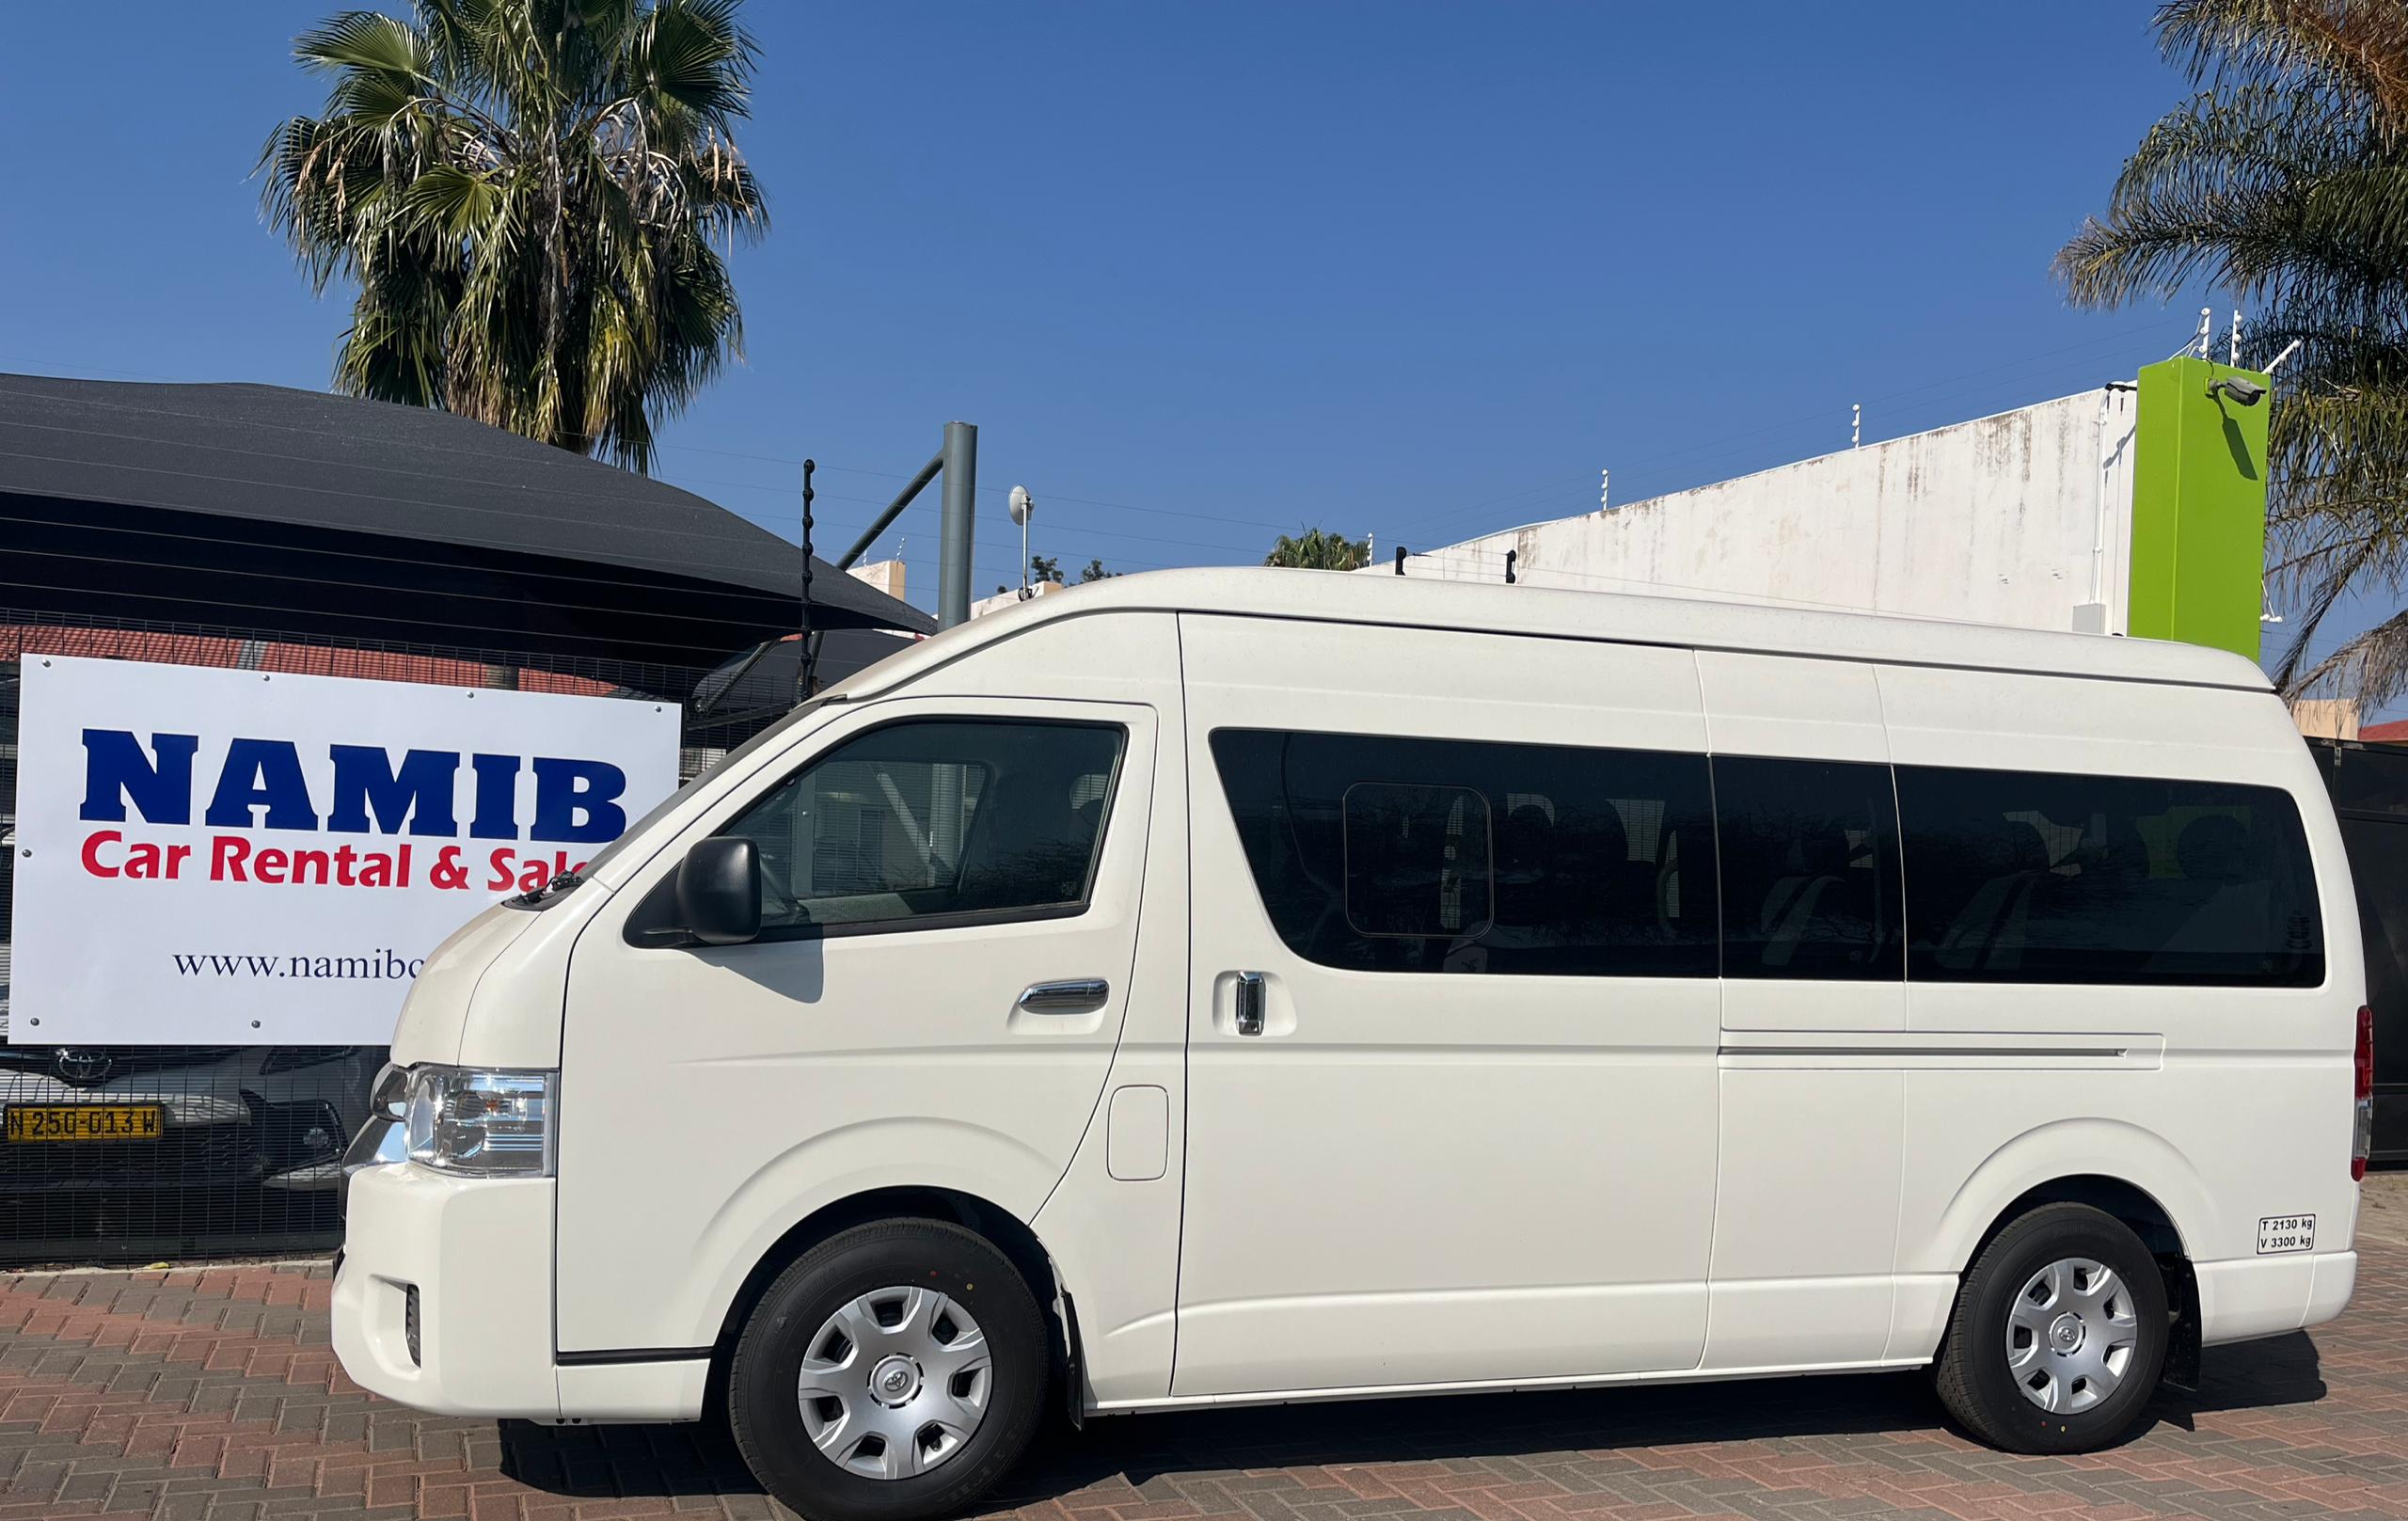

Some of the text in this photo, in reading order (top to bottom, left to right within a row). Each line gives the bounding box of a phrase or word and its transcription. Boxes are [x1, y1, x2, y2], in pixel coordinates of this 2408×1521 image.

[79, 728, 627, 844] NAMIB
[81, 830, 588, 893] Car Rental & Sal
[10, 1110, 24, 1135] N
[143, 1110, 155, 1133] W
[2262, 1217, 2313, 1231] T 2130 kg
[2260, 1234, 2311, 1248] V 3300 kg
